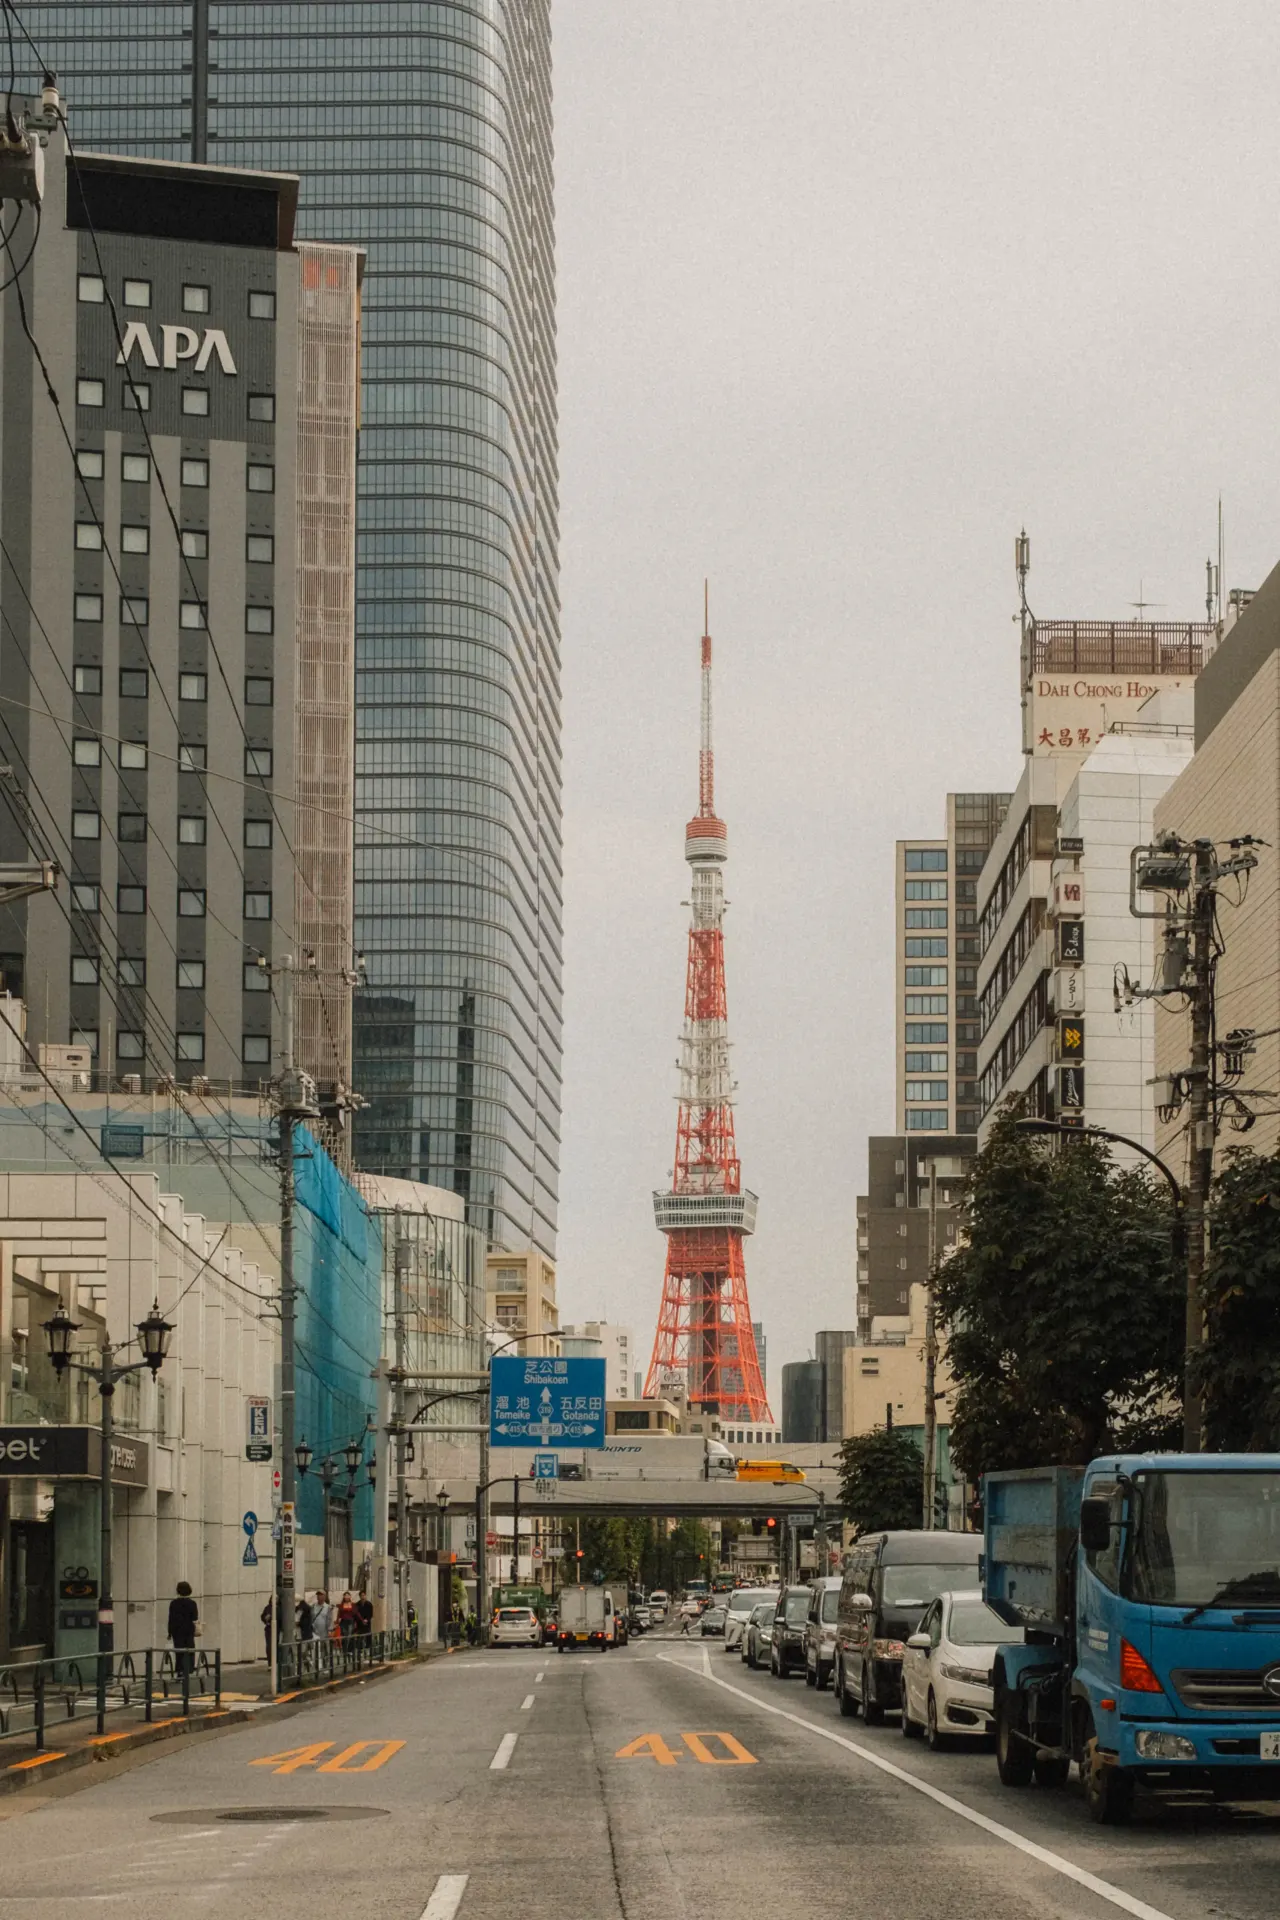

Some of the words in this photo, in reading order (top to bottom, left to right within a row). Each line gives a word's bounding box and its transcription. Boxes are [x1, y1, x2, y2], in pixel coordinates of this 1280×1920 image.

[116, 321, 237, 374] APA
[1038, 681, 1070, 698] DAH
[1074, 681, 1123, 698] CHONG
[525, 1360, 568, 1374] 芝公園
[523, 1374, 568, 1385] Shibakoen
[540, 1406, 552, 1414] 319
[560, 1396, 602, 1410] 五反田
[254, 1408, 265, 1435] KEN
[494, 1410, 531, 1420] Tameike
[562, 1410, 600, 1420] Gotanda
[509, 1425, 521, 1433] 415
[570, 1425, 582, 1434] 415
[614, 1732, 760, 1766] 40
[247, 1740, 407, 1774] 40
